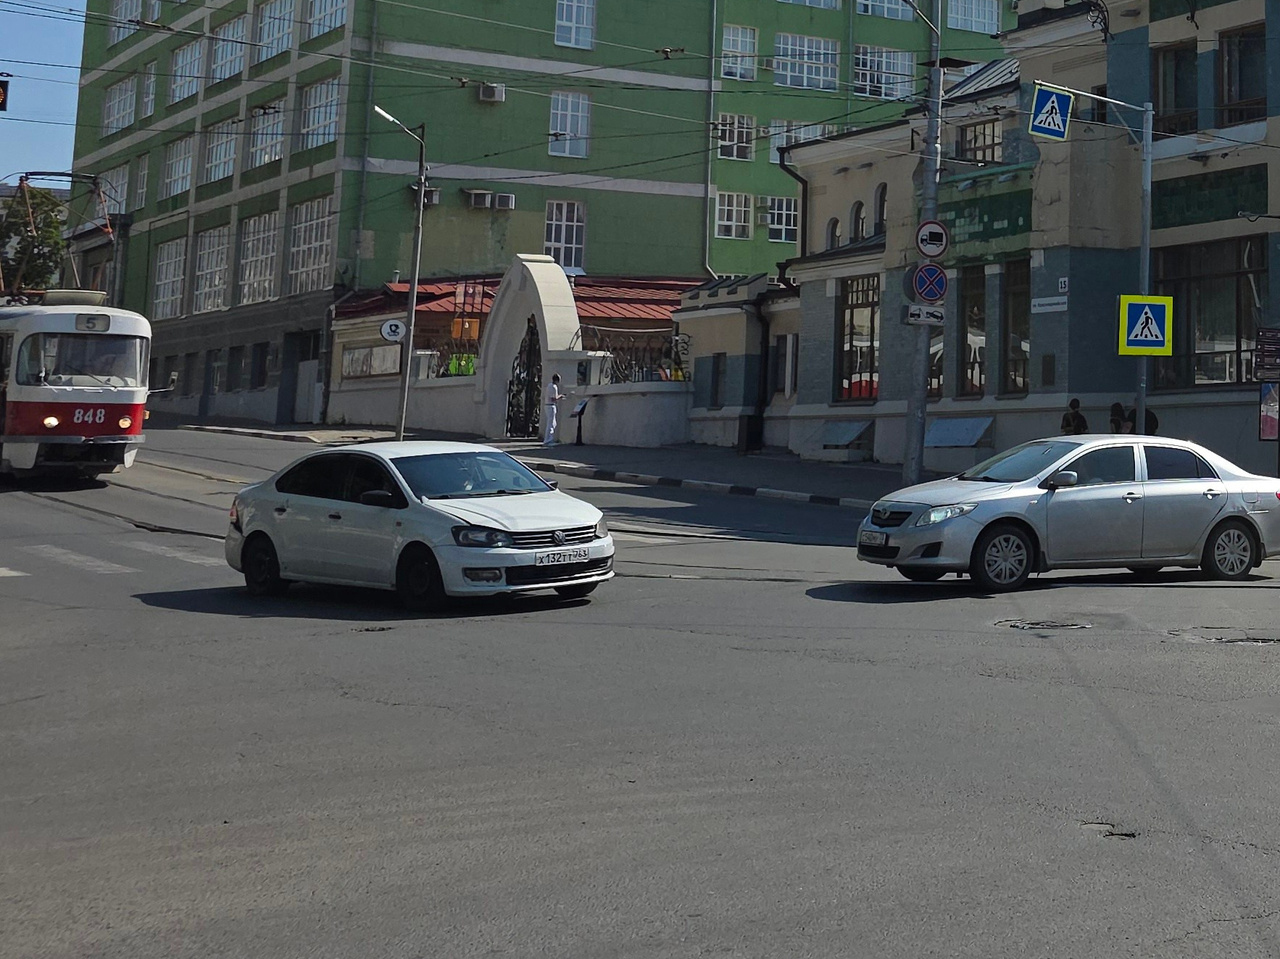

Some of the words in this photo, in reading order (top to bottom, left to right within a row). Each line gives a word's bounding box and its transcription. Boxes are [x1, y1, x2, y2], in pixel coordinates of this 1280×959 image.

[1060, 280, 1067, 289] 15
[85, 317, 97, 330] 5
[73, 408, 105, 424] 848
